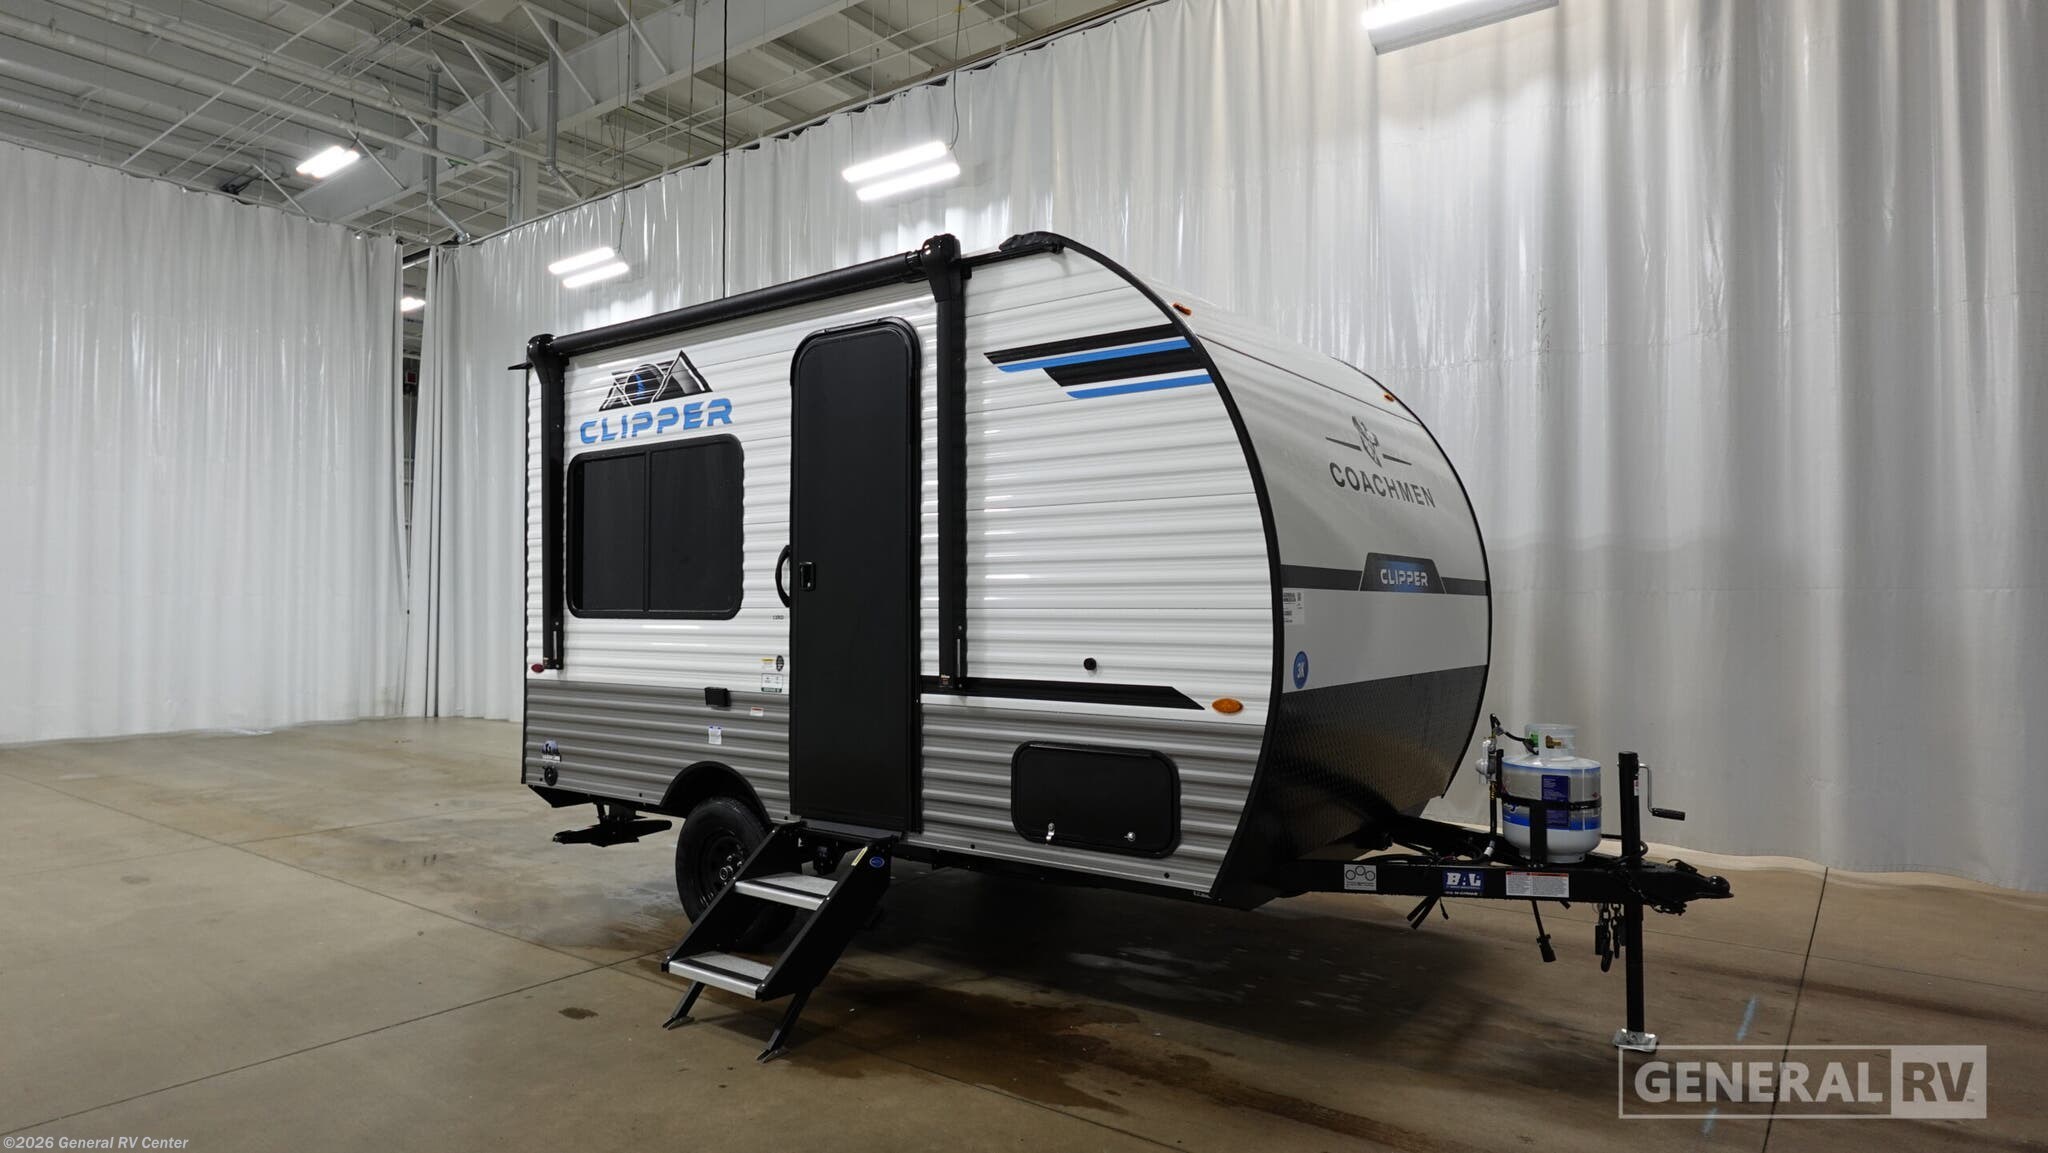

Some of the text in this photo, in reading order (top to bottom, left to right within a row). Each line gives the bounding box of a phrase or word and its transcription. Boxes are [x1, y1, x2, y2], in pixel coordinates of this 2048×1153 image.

[580, 398, 733, 445] CLIPPER
[1329, 462, 1436, 508] COACHMEN
[1380, 569, 1428, 587] CLIPPER
